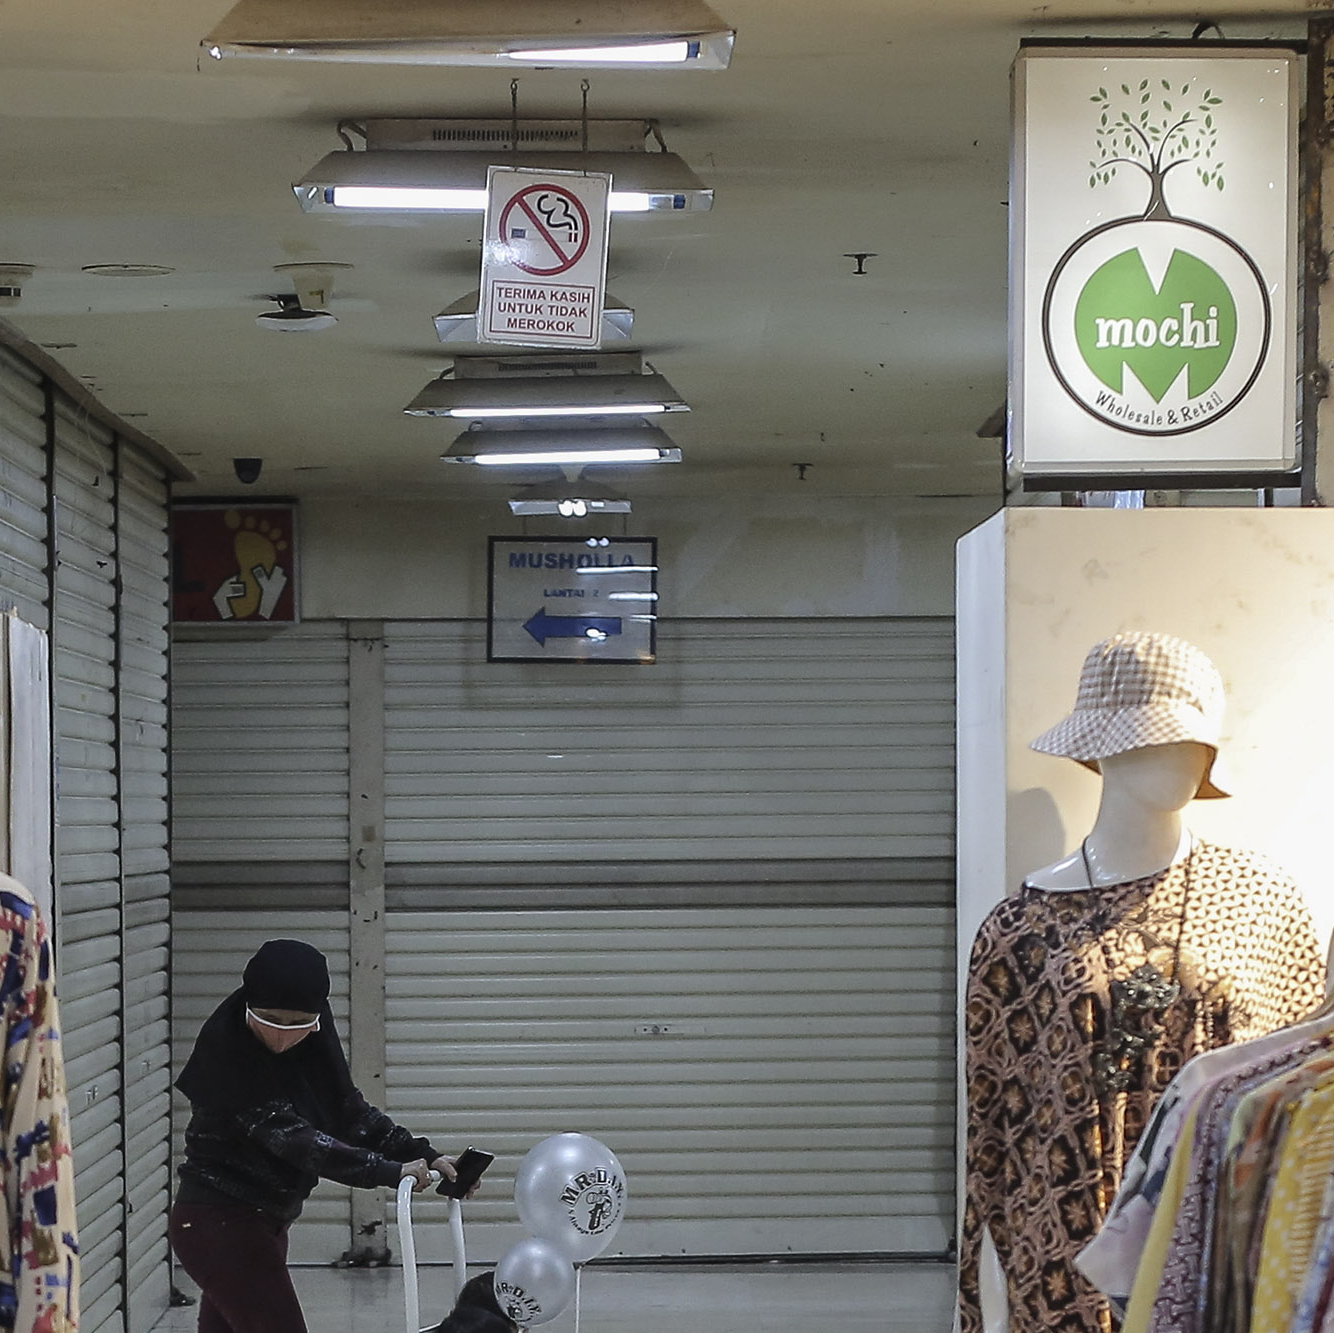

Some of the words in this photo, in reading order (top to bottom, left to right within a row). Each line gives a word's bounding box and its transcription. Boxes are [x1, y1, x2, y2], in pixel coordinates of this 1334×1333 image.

[497, 286, 546, 300] TERIMA
[550, 289, 590, 304] KASIH
[498, 302, 543, 315] UNTUK
[548, 304, 588, 318] TIDAK
[507, 317, 576, 332] MEROKOK
[1095, 302, 1220, 349] mochi
[1094, 390, 1163, 426] Wholesale
[1167, 409, 1179, 425] &
[1180, 391, 1224, 423] Retail
[508, 552, 634, 569] MUSHOLLA
[543, 588, 585, 598] LANTAI
